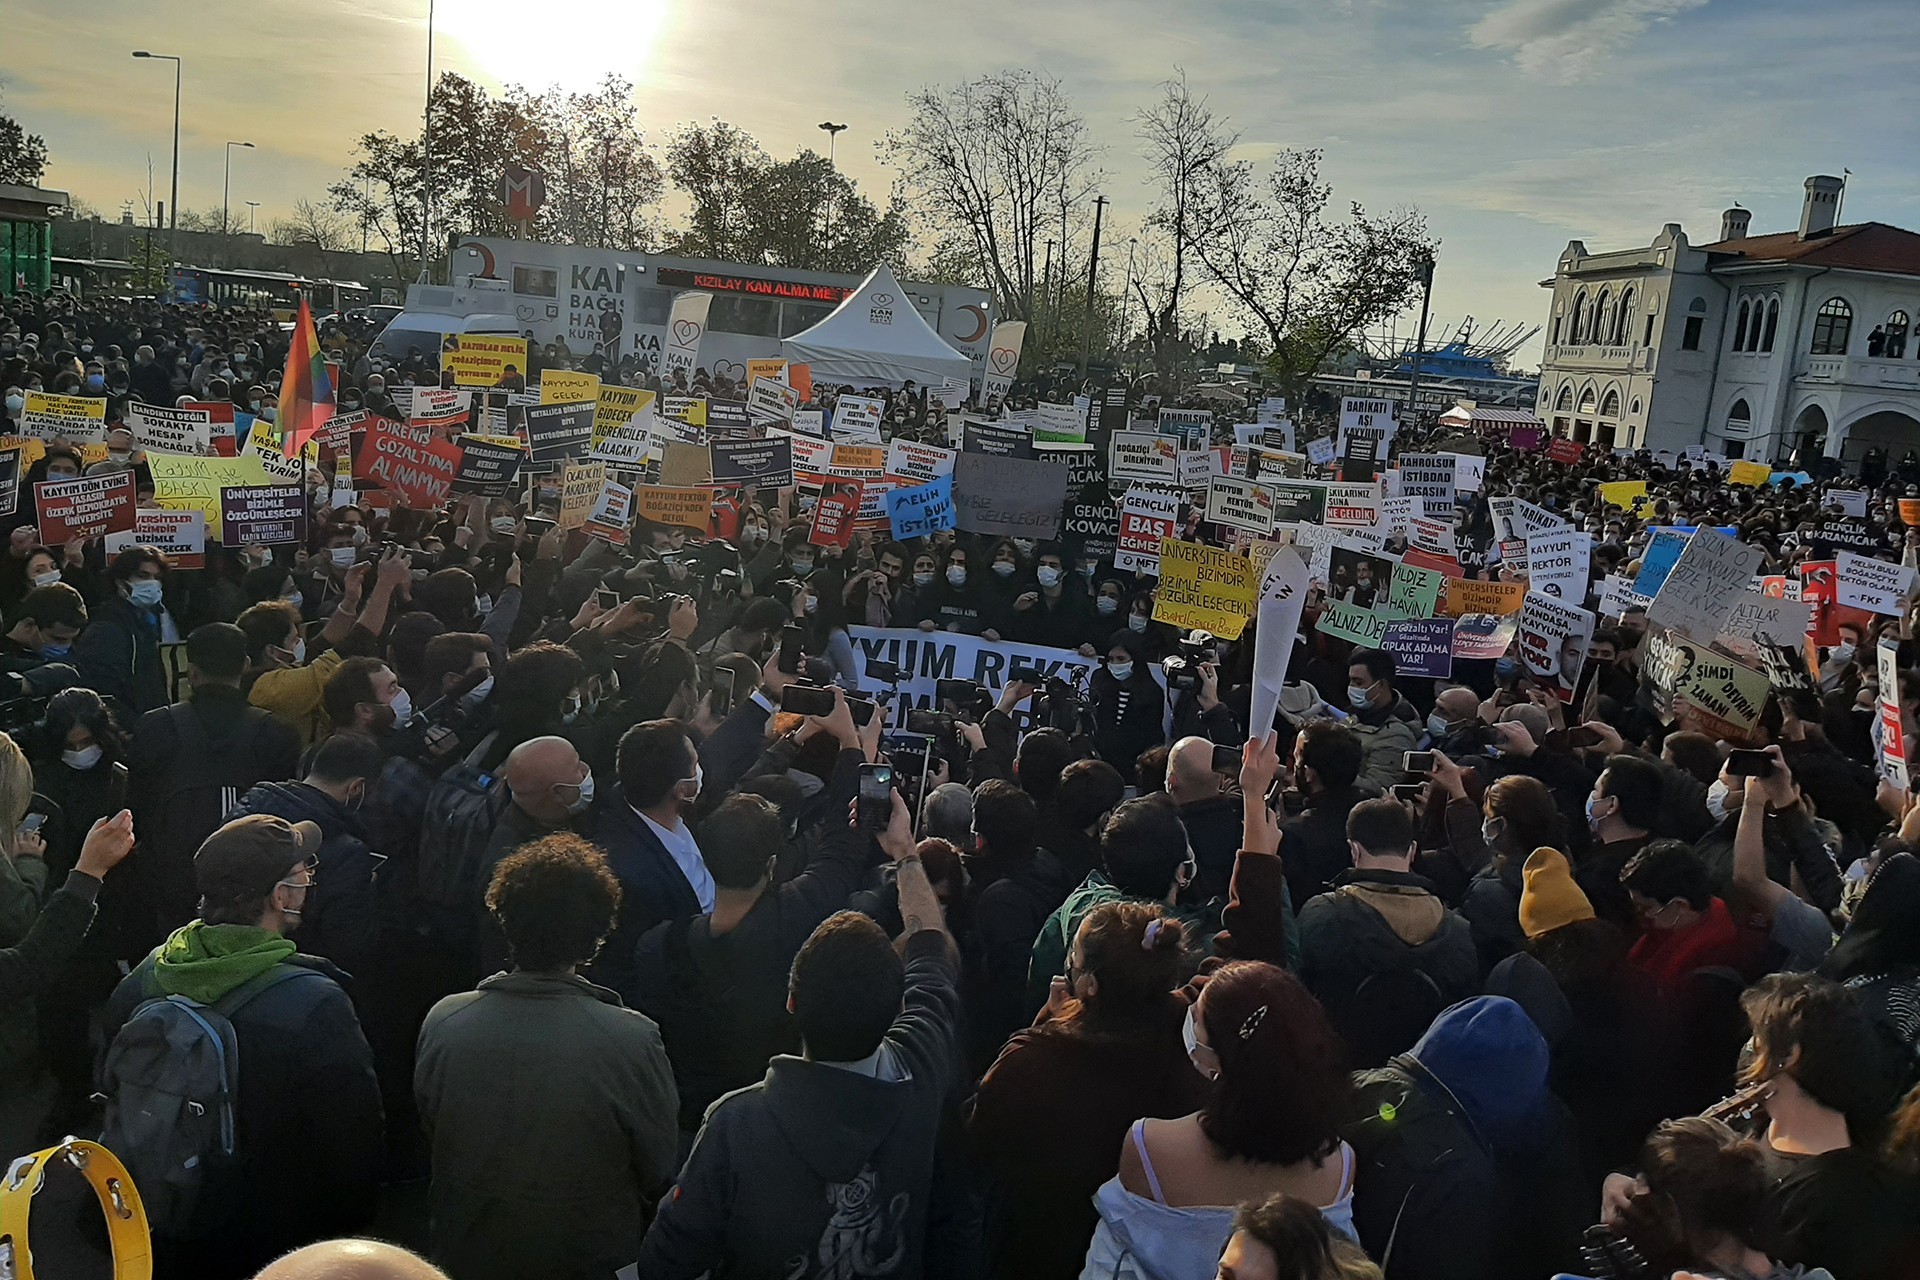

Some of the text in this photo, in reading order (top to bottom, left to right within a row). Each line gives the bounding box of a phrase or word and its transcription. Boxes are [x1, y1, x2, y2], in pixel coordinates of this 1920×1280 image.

[694, 275, 811, 299] KIZILAY KAN ALMA
[870, 308, 893, 317] KAN
[668, 352, 693, 367] KAN
[552, 391, 584, 401] GELEN
[131, 404, 207, 422] SANDIKTA DEĞİL
[596, 405, 635, 424] GİDECEK
[1347, 400, 1389, 414] BARİKATI
[142, 416, 195, 432] SOKAKTA
[594, 420, 648, 443] ÖĞRENCİLER
[148, 428, 185, 441] HESAP
[255, 447, 280, 464] TEK
[592, 440, 633, 457] KALACAK
[1400, 457, 1455, 469] KAHROLSUN
[82, 479, 102, 492] DÖN
[102, 473, 128, 489] EVİNE
[369, 455, 451, 501] ALINAMAZ
[864, 470, 883, 479] EVİNE
[1402, 470, 1451, 483] İSTİBDAD
[226, 486, 302, 501] ÜNİVERSİTELER
[644, 489, 677, 501] KAYYUM
[45, 495, 129, 519] ÖZERK DEMOKRATİK
[246, 499, 286, 511] BİZİMLE
[1126, 496, 1176, 515] GENÇLİK
[64, 508, 114, 527] ÜNİVERSİTE
[226, 507, 304, 522] ÖZGÜRLEŞECEK
[1127, 515, 1166, 542] BAŞ
[1530, 541, 1572, 555] KAYYUM
[1135, 557, 1159, 570] MFT
[1531, 557, 1572, 571] REKTÖR
[1392, 564, 1428, 588] YILDIZ
[1401, 586, 1418, 598] VE
[1450, 581, 1518, 597] ÜNİVERSİTELER
[1859, 593, 1882, 606] FKF
[1324, 603, 1364, 635] YALNIZ
[1523, 604, 1572, 631] YANDAŞA,
[1387, 623, 1450, 635] 37 Gözaltı Var!
[1522, 616, 1569, 640] KAYYUMA
[1413, 642, 1449, 655] ARAMA
[1401, 653, 1424, 665] VAR!
[1696, 660, 1734, 682] ŞİMDİ
[1689, 684, 1731, 718] ZAMANI
[1720, 683, 1758, 722] DEVRİM
